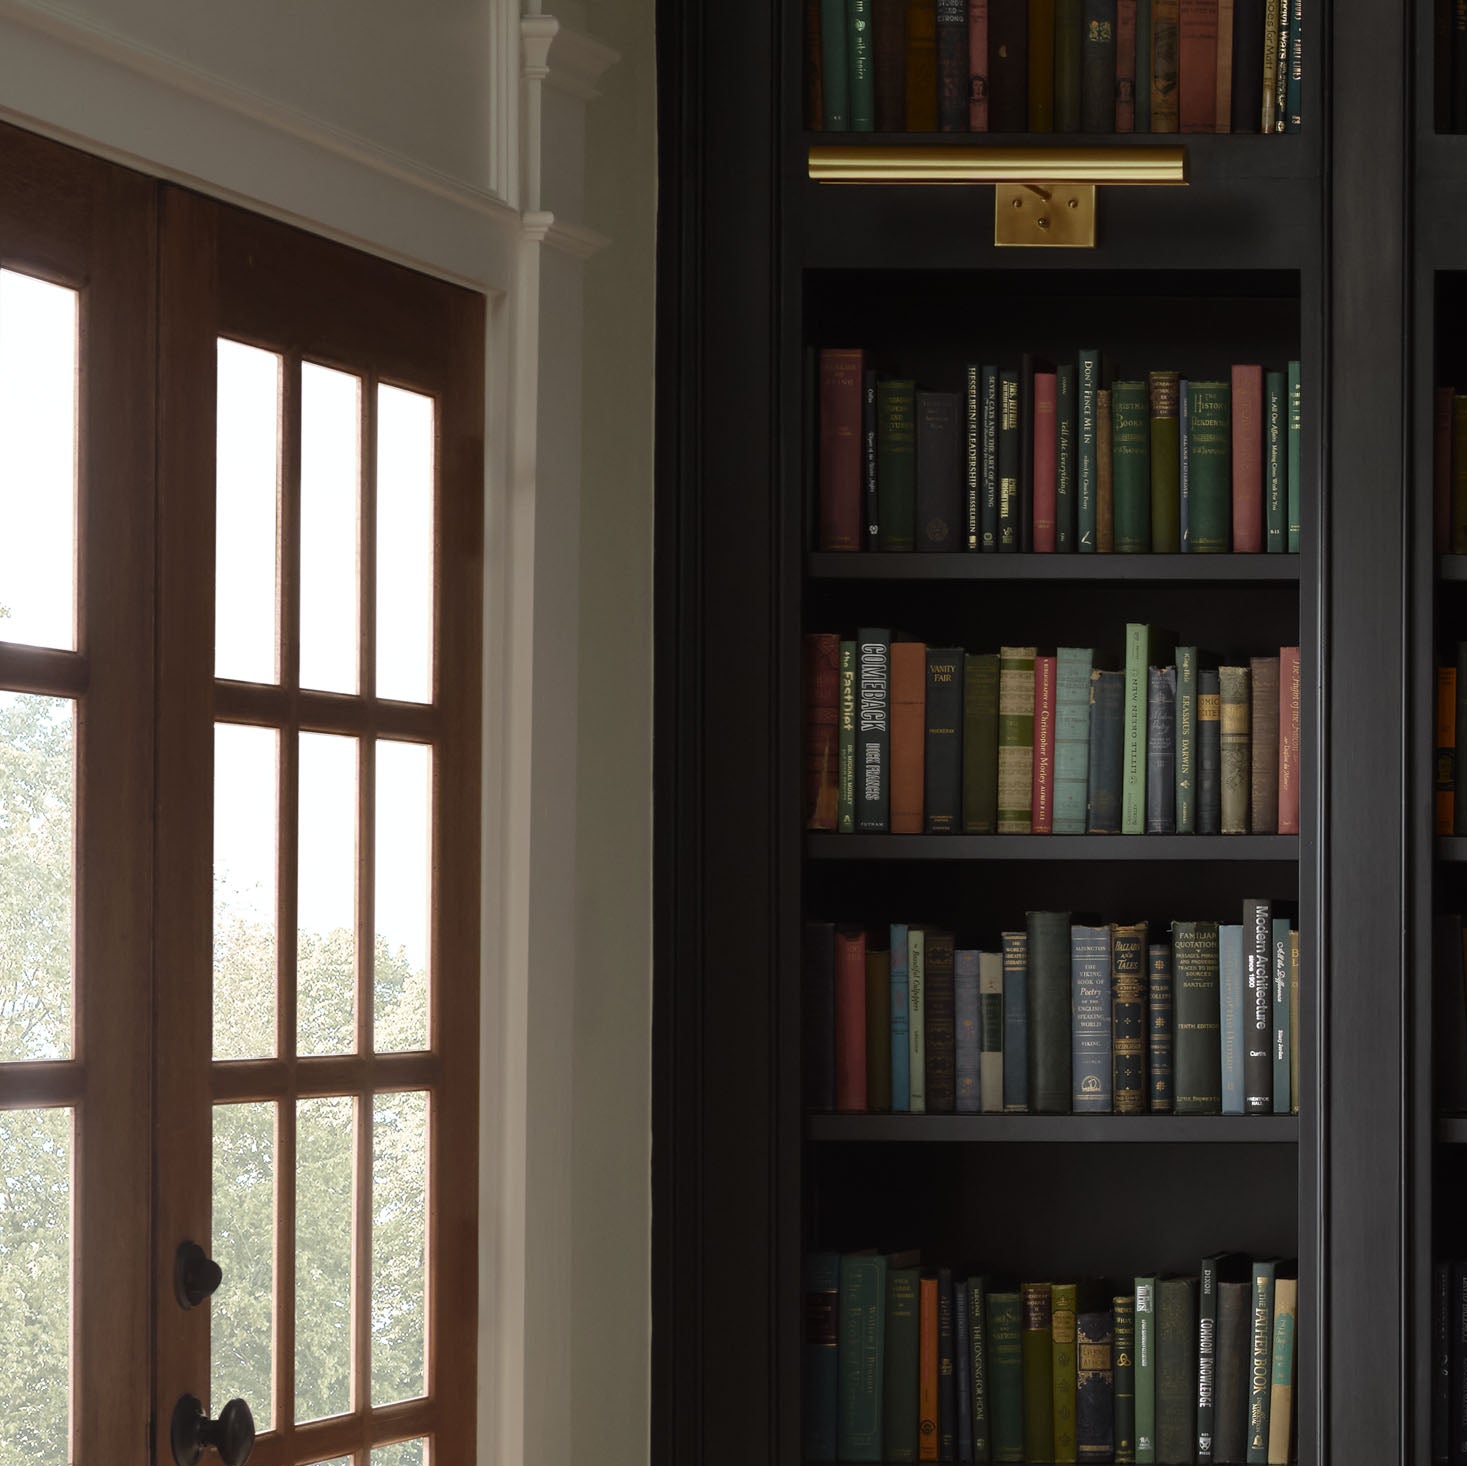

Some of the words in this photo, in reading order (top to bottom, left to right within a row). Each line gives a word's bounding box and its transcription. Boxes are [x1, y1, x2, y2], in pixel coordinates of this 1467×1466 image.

[1084, 361, 1092, 388] DON'T
[1084, 418, 1092, 431] ME
[1084, 434, 1092, 443] IN
[1061, 438, 1068, 450] Me
[988, 471, 994, 480] OF
[1059, 453, 1068, 494] Everything
[861, 644, 887, 731] COMEBACK
[1040, 711, 1049, 754] Christopher
[1182, 696, 1190, 735] ERASMUS
[866, 743, 880, 763] DICK
[866, 765, 880, 800] FRANCIS
[1256, 906, 1269, 953] Modern
[1256, 956, 1268, 1030] Architecture
[1254, 1308, 1267, 1356] FATHER
[1253, 1359, 1266, 1395] BOOK
